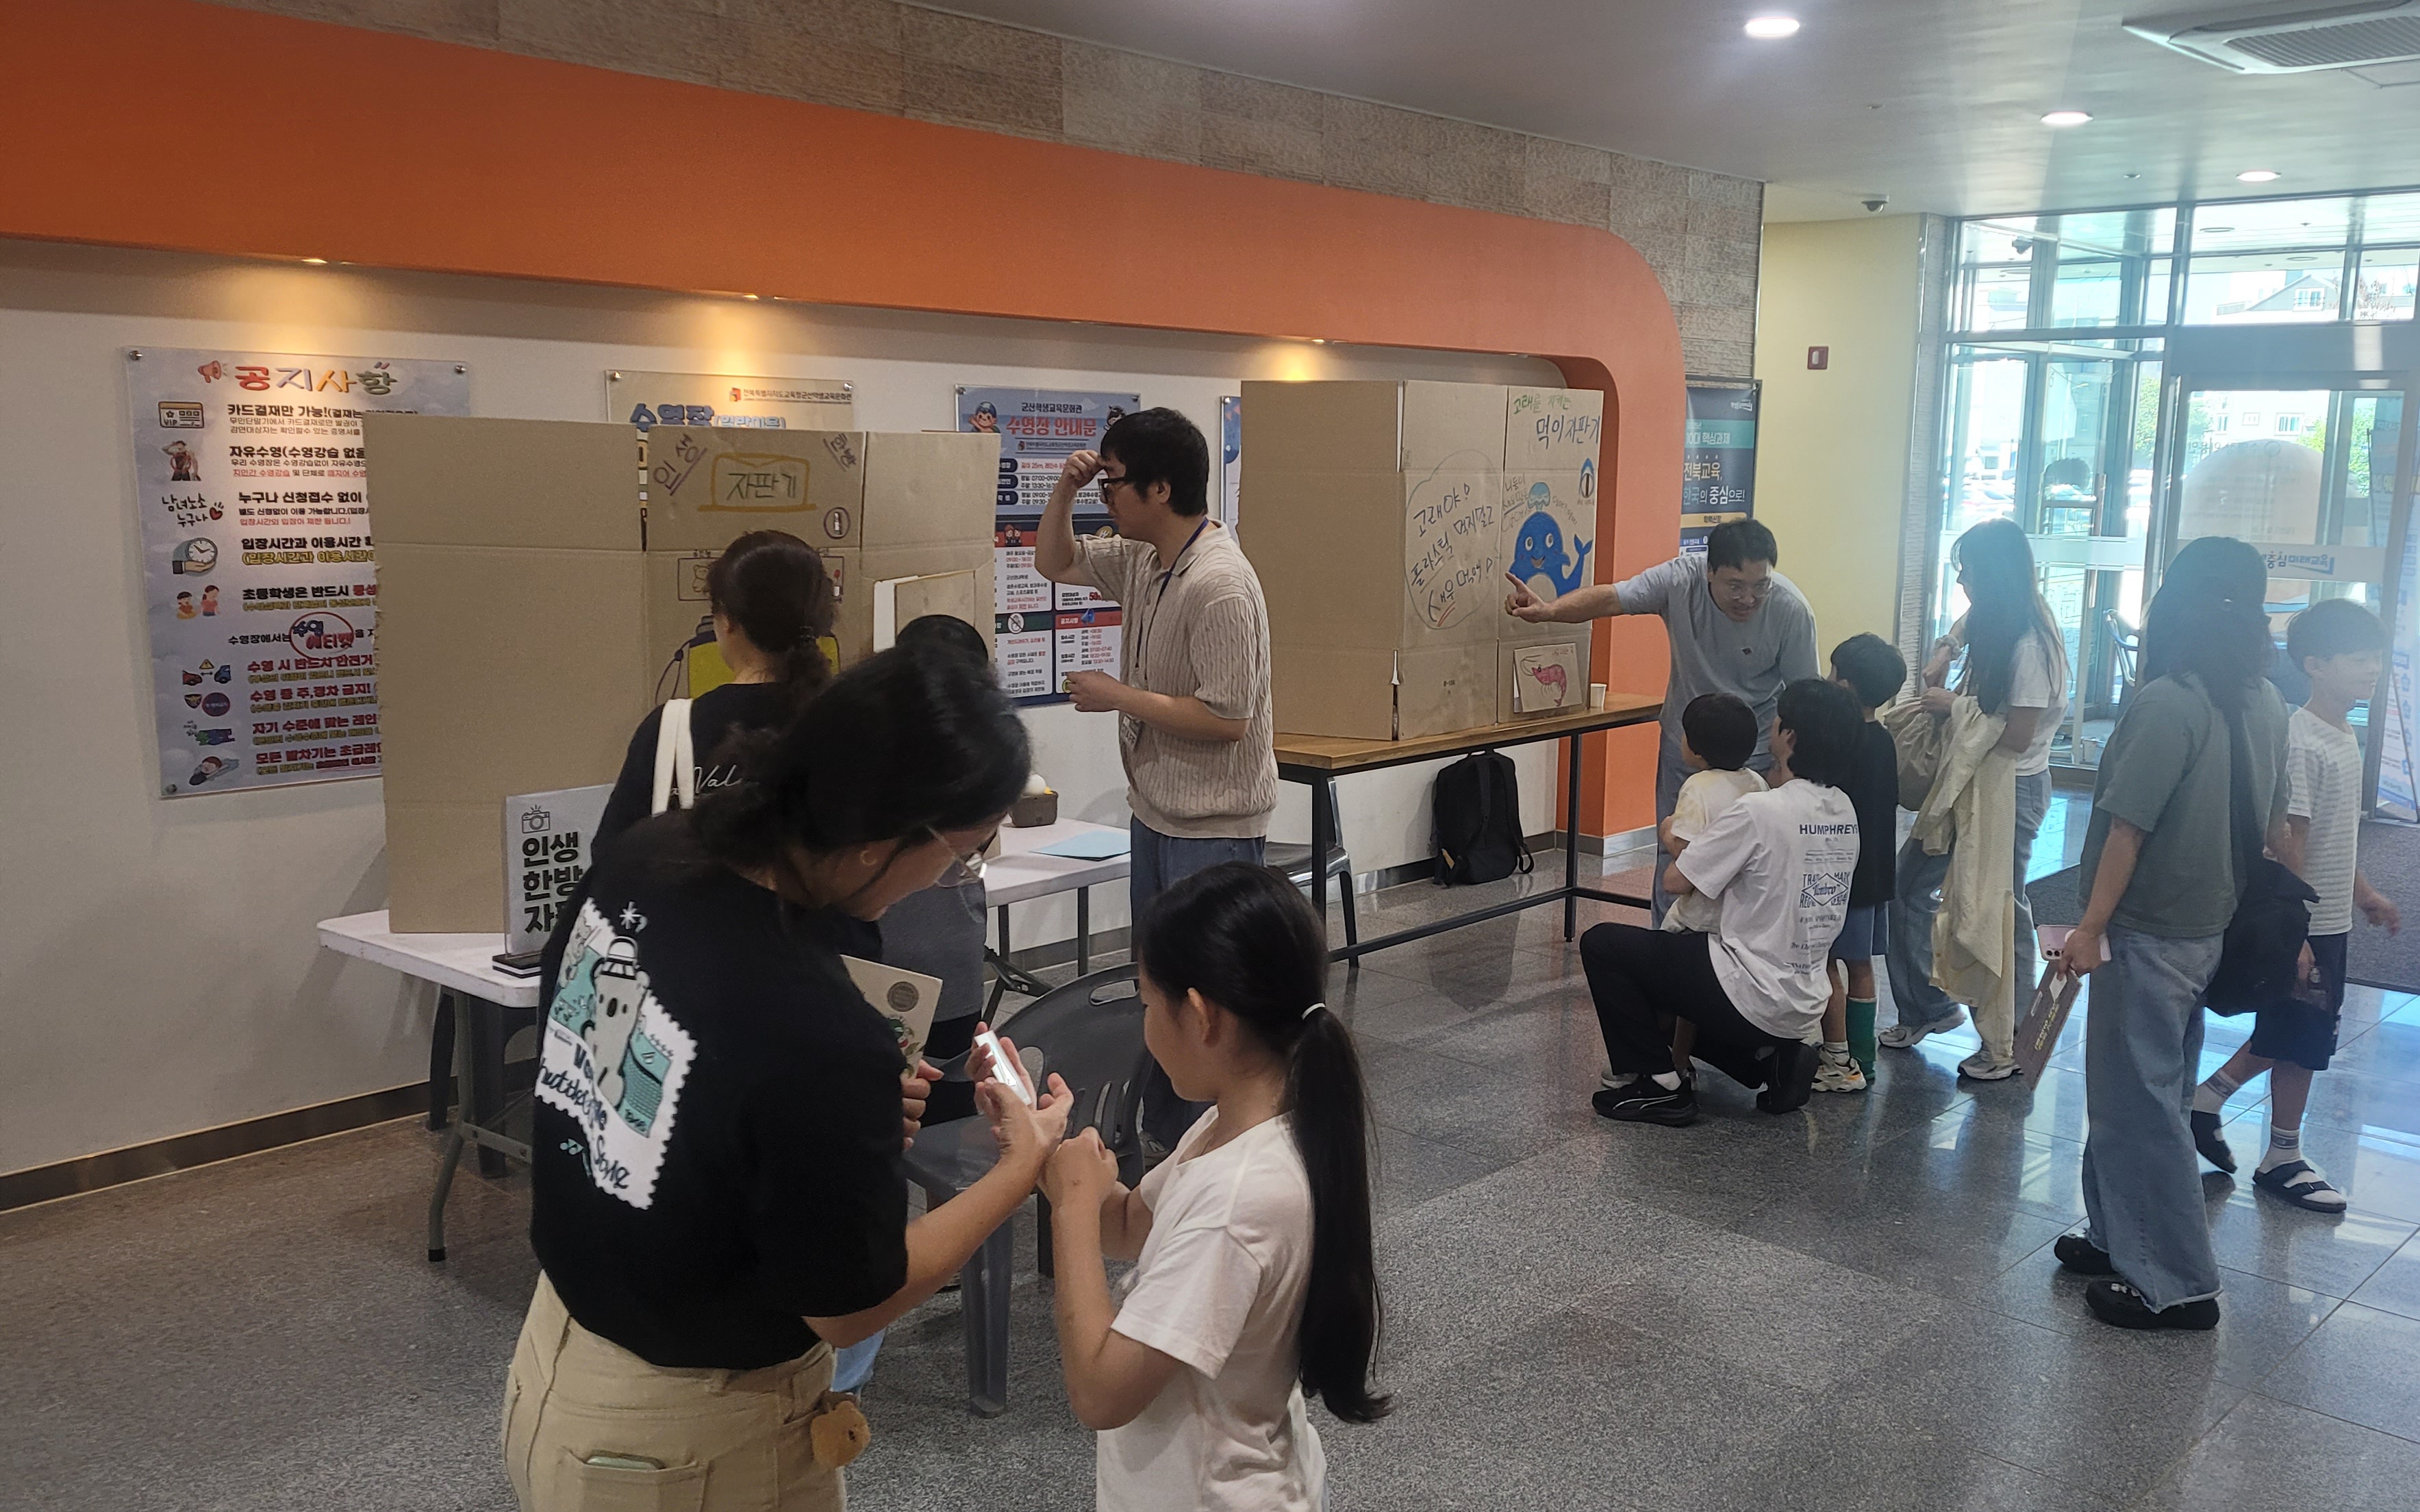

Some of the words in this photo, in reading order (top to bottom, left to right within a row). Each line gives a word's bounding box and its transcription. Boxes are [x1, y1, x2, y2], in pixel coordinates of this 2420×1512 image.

[234, 363, 398, 395] 공지사항
[227, 404, 294, 416] 카드결재만
[1021, 402, 1083, 414] 군산학생교육문화관
[1513, 394, 1541, 414] 고래를
[1548, 394, 1572, 410] 지키는
[1006, 416, 1050, 436] 수영장
[1054, 417, 1097, 436] 안내문
[1702, 431, 1730, 444] 핵심과제
[229, 446, 338, 458] 자유수영(수영강습
[653, 433, 702, 492] 인생
[1684, 462, 1723, 481] 전북교육,
[726, 473, 797, 501] 자판기
[1683, 486, 1708, 505] 한국의
[1709, 486, 1745, 505] 중심으로!
[162, 492, 207, 512] 남녀노소
[238, 492, 279, 504] 누구나
[282, 492, 333, 503] 신청접수
[338, 492, 362, 503] 없이
[177, 513, 208, 528] 누구나
[242, 538, 307, 550] 입장시간과
[311, 536, 362, 548] 이용시간
[242, 551, 314, 566] (입장시간과
[1411, 531, 1454, 588] 플라스틱
[242, 587, 307, 600] 초등학생은
[312, 585, 349, 598] 반드시
[228, 633, 291, 646] 수영장에서는
[247, 660, 273, 672] 수영
[278, 659, 290, 671] 시
[294, 657, 332, 670] 반드시
[251, 690, 276, 702] 수영
[342, 683, 371, 696] 금지!
[253, 722, 278, 734] 자기
[325, 716, 349, 728] 맞는
[256, 752, 282, 764] 모든
[286, 747, 336, 761] 발차기는
[522, 831, 579, 868] 인생
[522, 865, 583, 902] 한방
